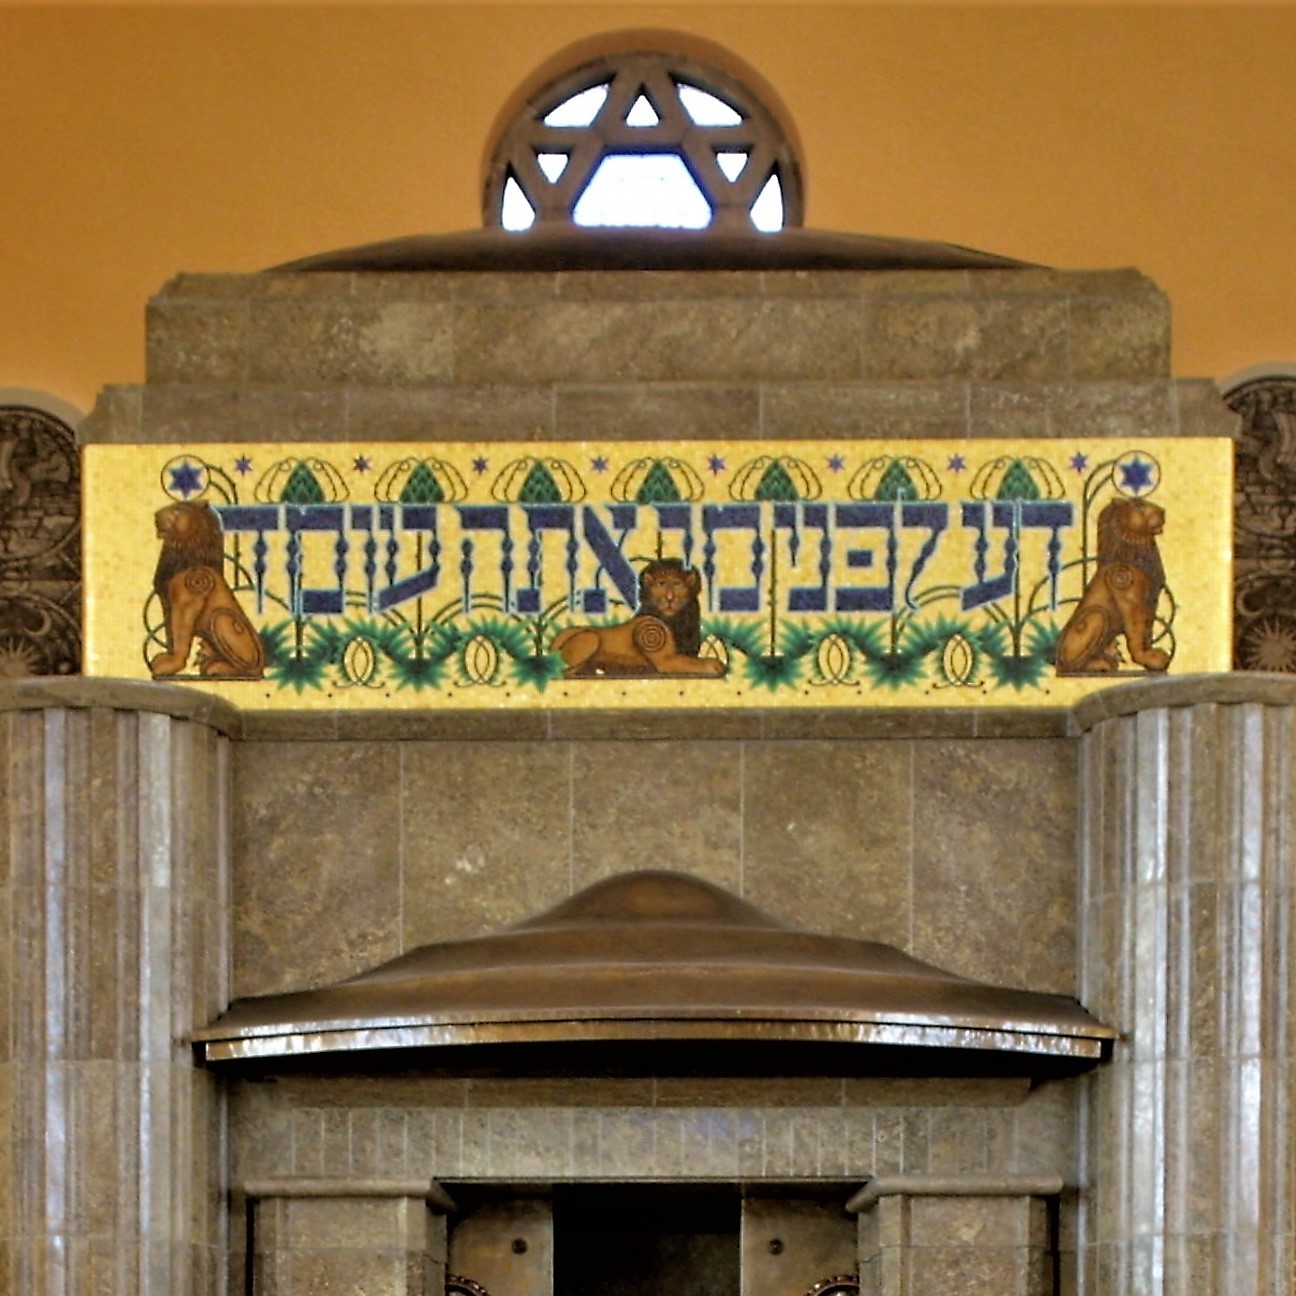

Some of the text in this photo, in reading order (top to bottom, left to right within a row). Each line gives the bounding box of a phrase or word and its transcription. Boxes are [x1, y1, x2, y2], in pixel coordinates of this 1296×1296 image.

[212, 488, 1073, 614] דע לפני מי אתה עומד
